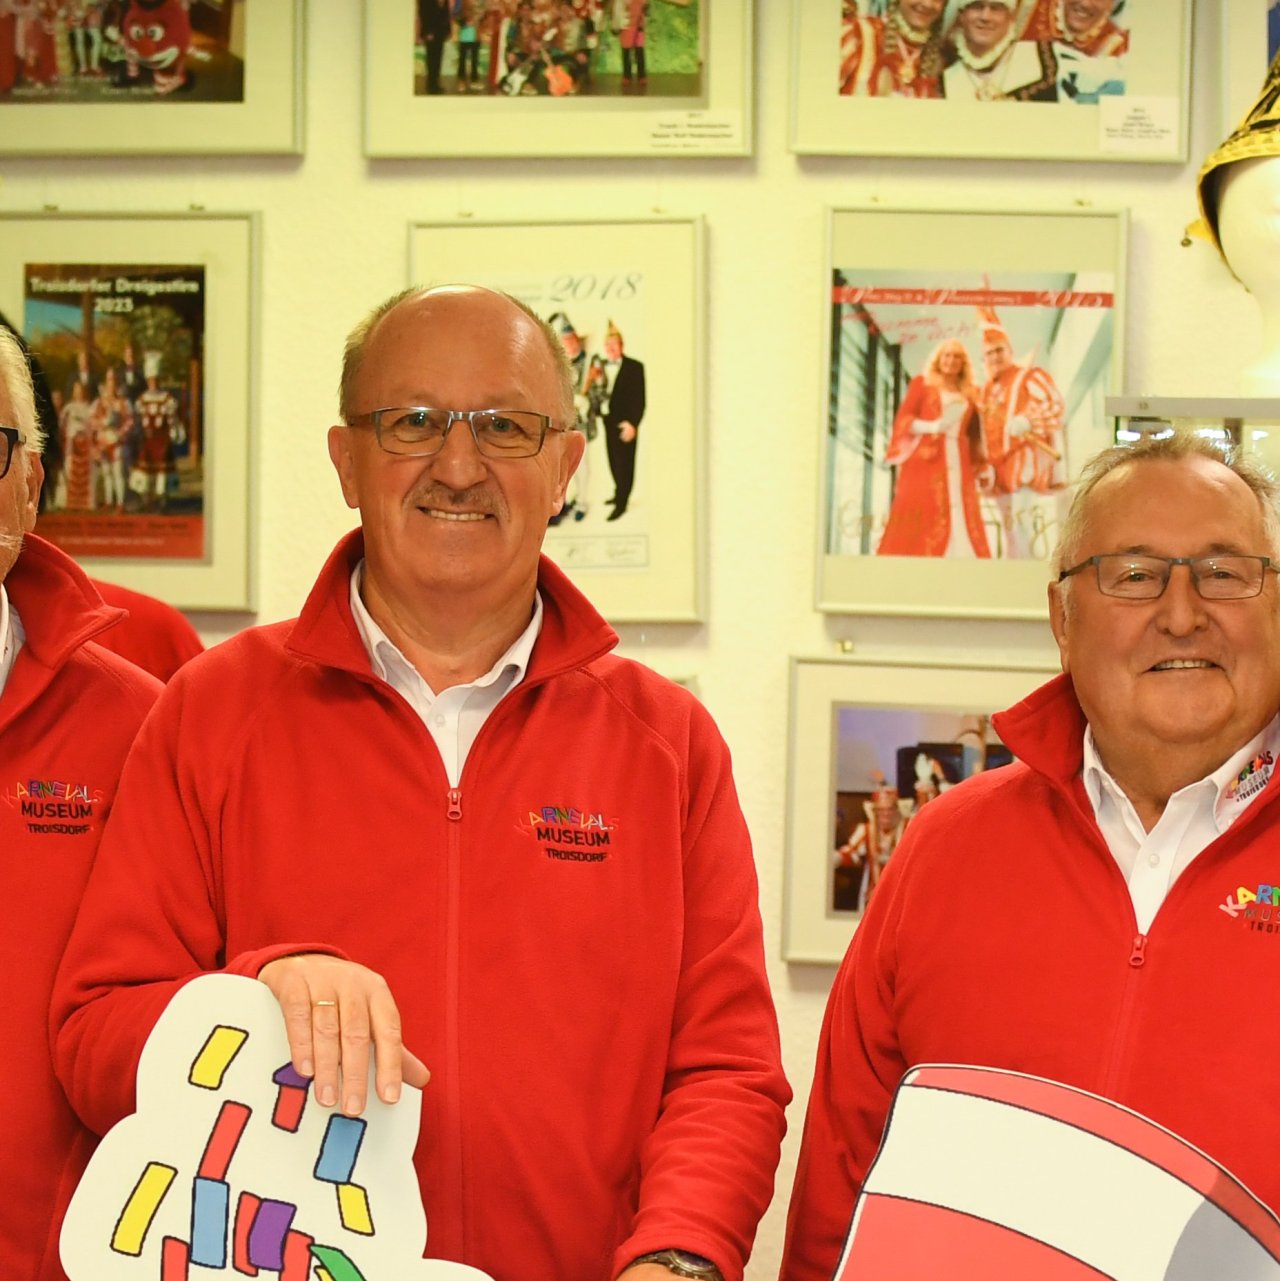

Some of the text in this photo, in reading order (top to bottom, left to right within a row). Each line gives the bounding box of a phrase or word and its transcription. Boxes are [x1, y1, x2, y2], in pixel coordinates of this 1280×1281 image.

[30, 277, 201, 296] Troisdorfer Dreigestirn
[549, 271, 643, 303] 2018
[93, 296, 135, 313] 2023
[21, 800, 93, 819] MUSEUM
[27, 823, 90, 835] TROISDORF
[536, 827, 611, 847] MUSEUM
[545, 847, 607, 862] TROISDORF
